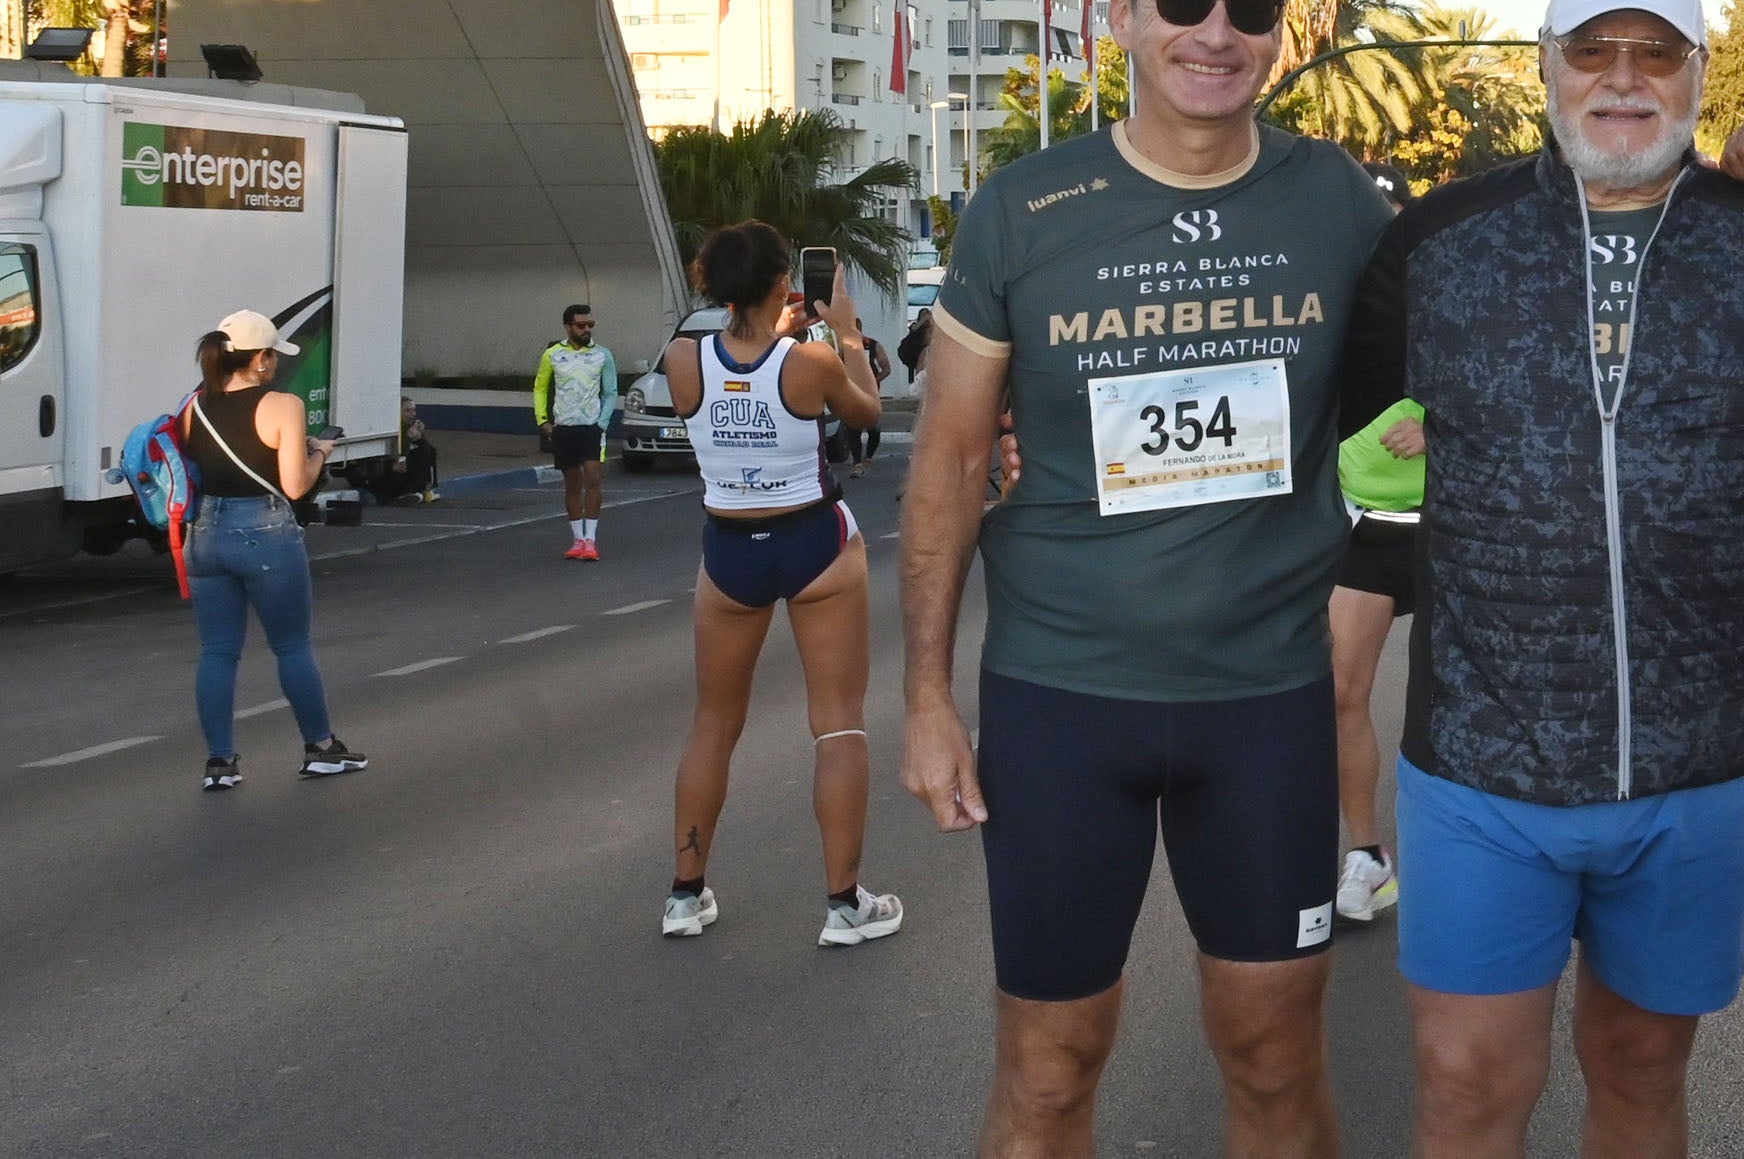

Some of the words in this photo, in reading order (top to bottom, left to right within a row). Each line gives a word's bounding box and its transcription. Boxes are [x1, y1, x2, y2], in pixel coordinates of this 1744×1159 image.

[121, 145, 303, 200] enterprise
[244, 192, 302, 208] rent-a-car
[1027, 183, 1087, 213] luanvi
[1172, 208, 1223, 244] SB
[1096, 260, 1187, 280] SIERRA
[1198, 253, 1289, 271] BLANCA
[1139, 274, 1251, 295] ESTATES
[1049, 292, 1325, 346] MARBELLA
[1077, 347, 1148, 372] HALF
[1158, 337, 1301, 363] MARATHON
[710, 399, 776, 429] CUA
[1139, 395, 1237, 456] 354
[712, 430, 777, 440] ATLETISMO
[1162, 454, 1206, 467] FERNANDO
[1218, 453, 1227, 461] LA
[1128, 473, 1178, 485] MEDIA
